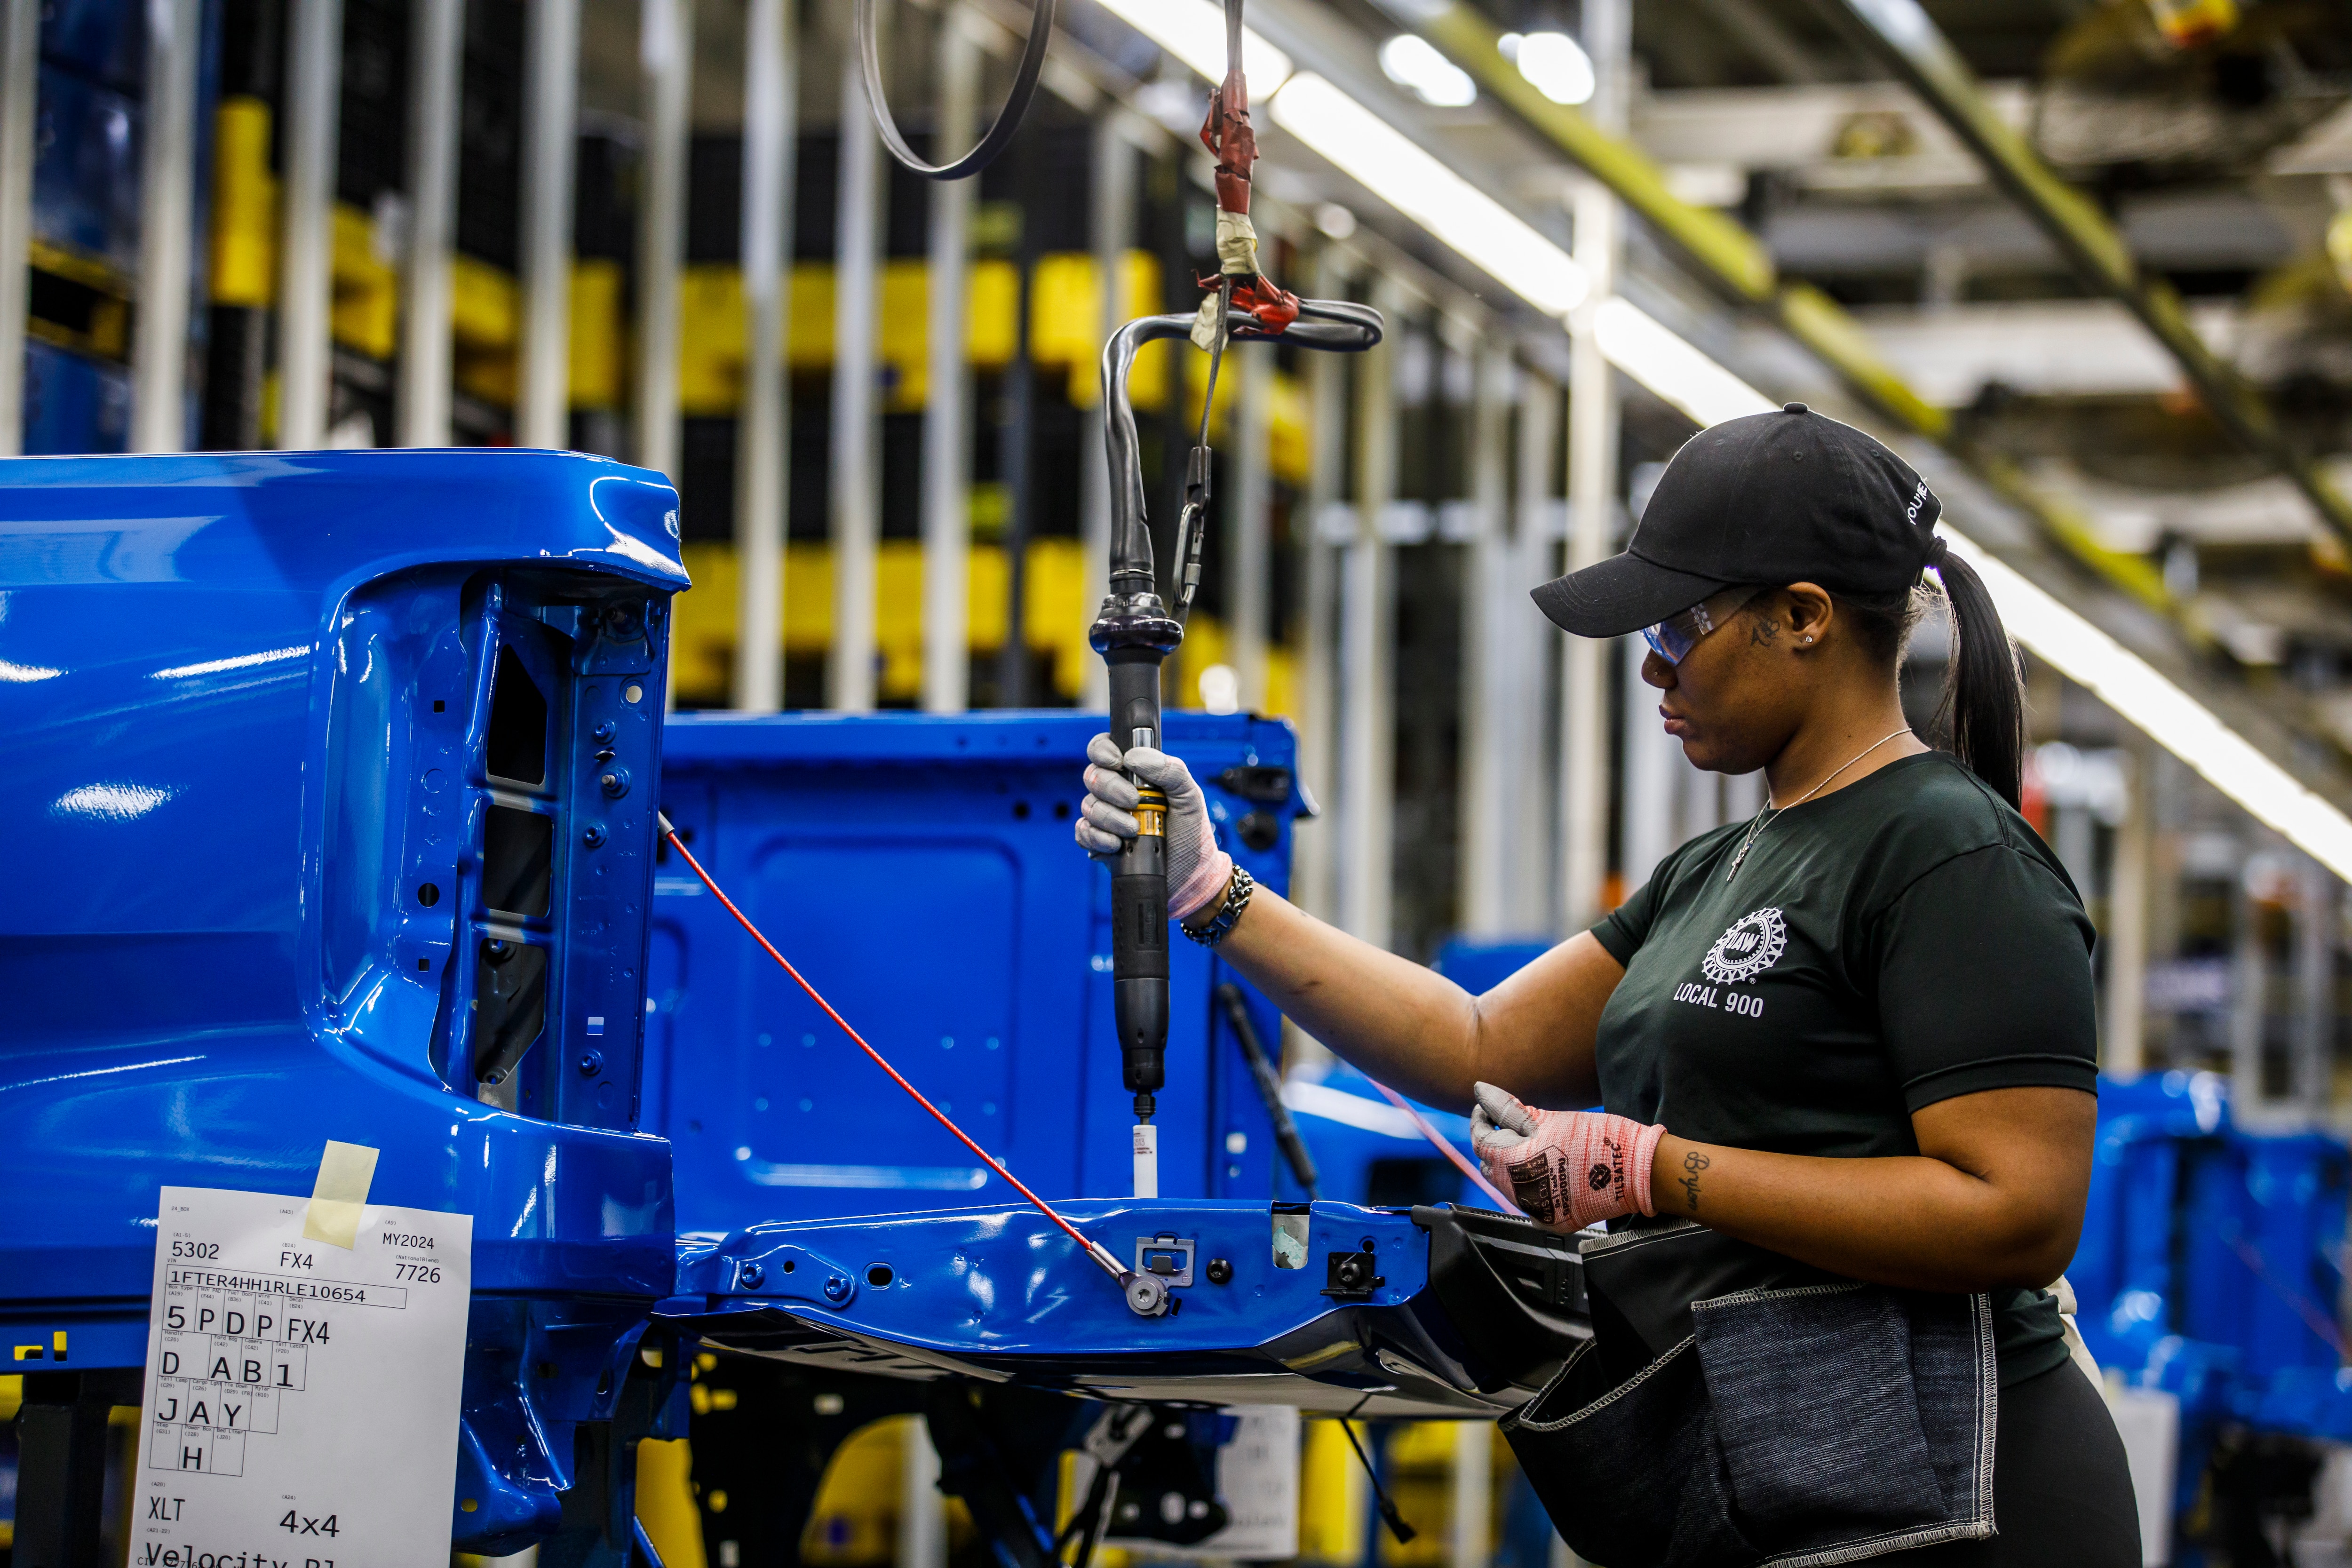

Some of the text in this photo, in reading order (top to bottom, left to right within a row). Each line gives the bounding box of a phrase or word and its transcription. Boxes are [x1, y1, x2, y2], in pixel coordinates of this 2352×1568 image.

[1725, 932, 1761, 953] UAW
[1673, 983, 1764, 1018] LOCAL 900
[1611, 1143, 1625, 1202] TILSATEC
[172, 1241, 220, 1259] 5302
[382, 1233, 435, 1250] MY2024
[280, 1251, 313, 1270] FX4
[396, 1263, 441, 1283] 7726
[171, 1271, 366, 1302] 1FTER4HH1RLE10654
[167, 1305, 185, 1329] 5
[199, 1308, 215, 1331] P
[227, 1311, 245, 1335] D
[258, 1314, 272, 1337] P
[288, 1318, 330, 1344] FX4
[163, 1352, 180, 1374] D
[211, 1357, 231, 1380] A
[244, 1360, 262, 1383] B
[277, 1364, 293, 1387] 1
[159, 1398, 178, 1421] J
[189, 1401, 210, 1425] A
[224, 1403, 242, 1427] Y
[183, 1446, 202, 1470] H
[149, 1496, 185, 1521] XLT
[279, 1510, 340, 1537] 4x4
